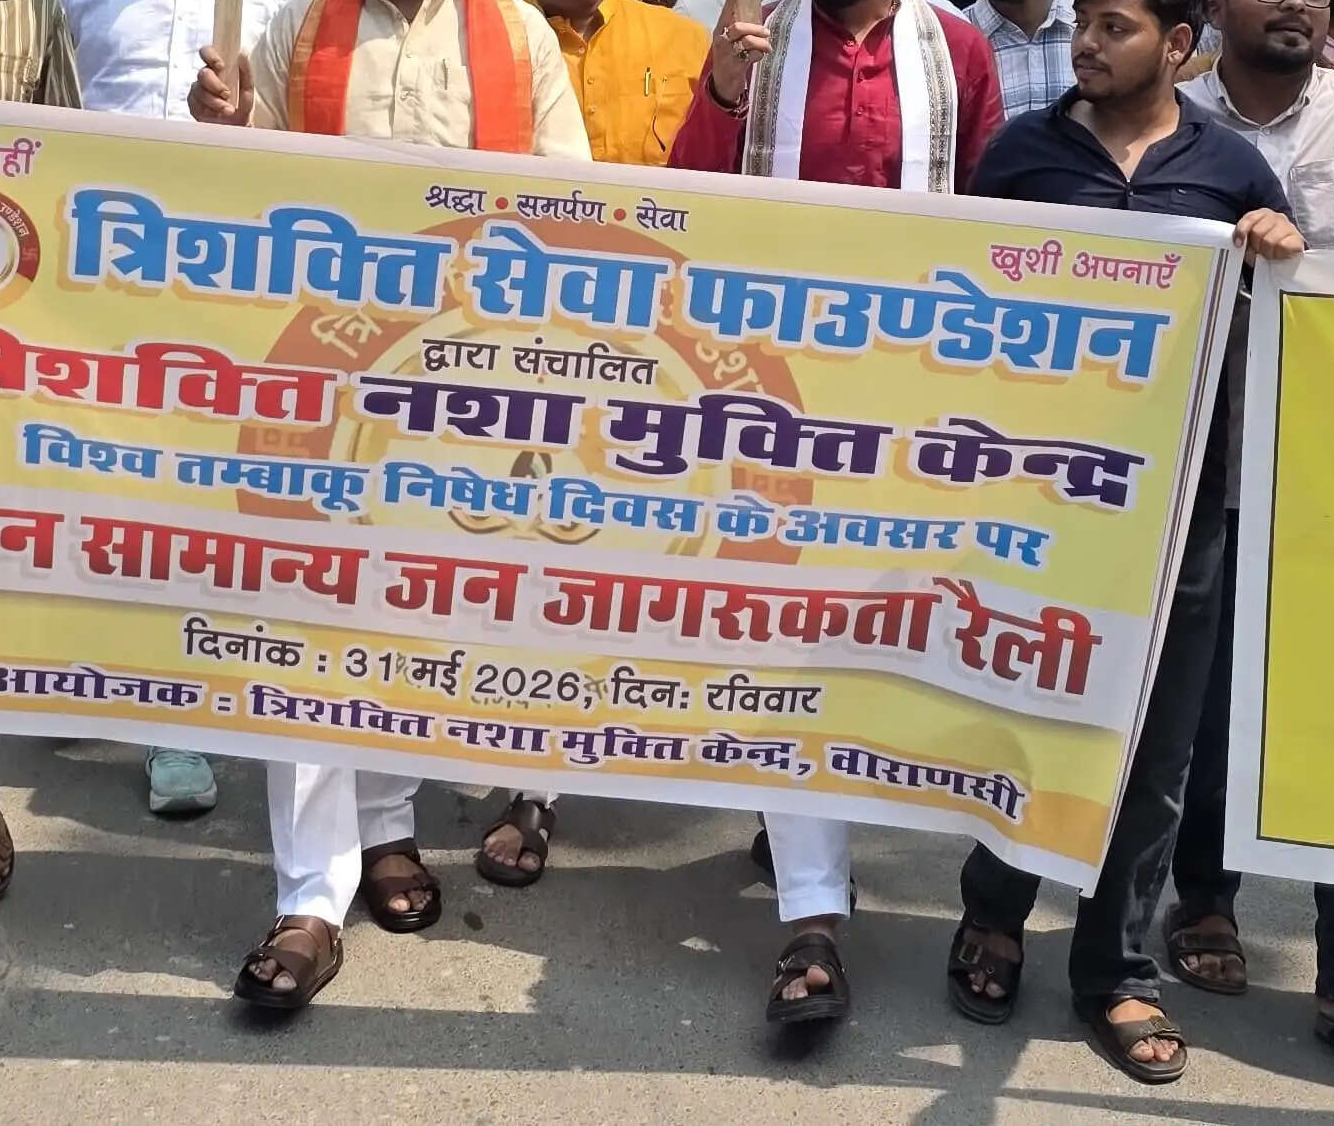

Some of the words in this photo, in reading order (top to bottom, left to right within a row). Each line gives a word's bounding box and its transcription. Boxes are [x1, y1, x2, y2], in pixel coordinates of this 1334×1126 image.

[425, 185, 486, 214] श्रद्धा
[517, 190, 607, 225] समर्पण
[636, 197, 689, 233] सेवा
[990, 239, 1062, 283] खुशी
[1072, 251, 1182, 291] अपनाएँ
[71, 190, 451, 309] त्रिशक्ति
[473, 226, 668, 328] सेवा
[689, 268, 1170, 378] फाउण्डेशन
[423, 338, 500, 372] द्वारा
[513, 337, 658, 386] संचालित
[23, 427, 162, 478] विश्व
[177, 450, 369, 514] तम्बाकू
[384, 461, 537, 520] निषेध
[548, 477, 701, 535] दिवस
[717, 495, 773, 541] के
[786, 508, 965, 552] अवसर
[975, 521, 1048, 567] पर
[359, 376, 586, 445] नशा
[608, 394, 893, 475] मुक्ति
[915, 417, 1146, 508] केन्द्र
[81, 515, 369, 605] सामान्य
[385, 552, 529, 623] जन
[932, 577, 1103, 697] रैली
[184, 617, 304, 669] दिनांक
[345, 649, 392, 682] 31
[411, 649, 466, 696] मई
[707, 673, 821, 715] रविवार
[252, 686, 433, 736] त्रिशक्ति
[447, 714, 548, 753] नशा
[561, 725, 686, 765] मुक्ति
[701, 732, 814, 777] केन्द्र,
[831, 745, 1026, 820] वाराणसी
